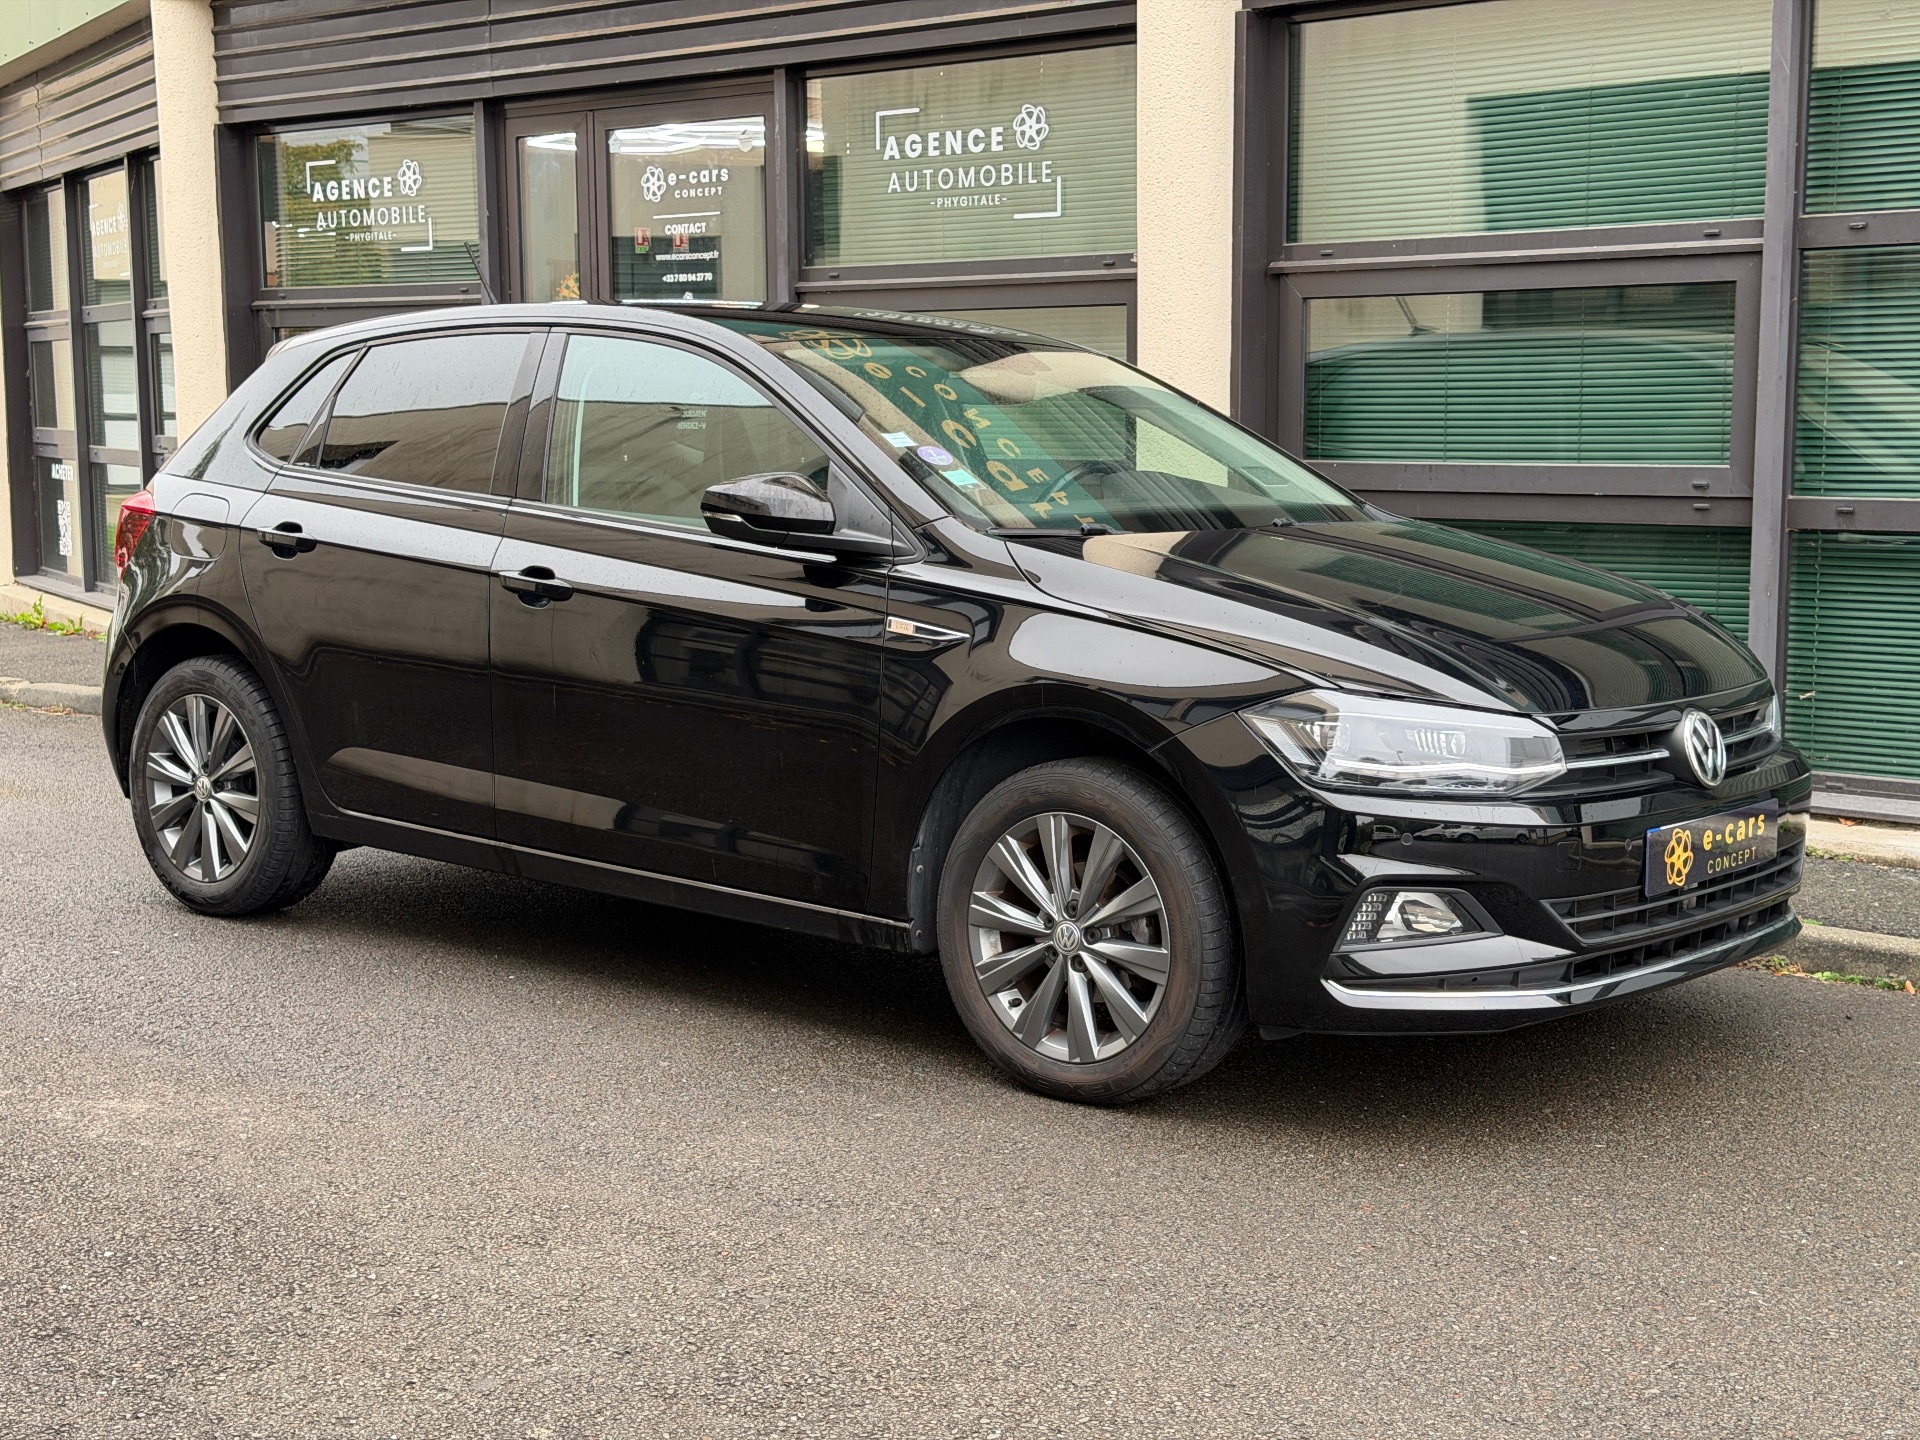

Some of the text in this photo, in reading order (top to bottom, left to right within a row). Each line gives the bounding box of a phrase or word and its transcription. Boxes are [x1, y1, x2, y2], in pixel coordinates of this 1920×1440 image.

[883, 126, 1004, 161] AGENCE
[312, 176, 393, 202] AGENCE
[667, 168, 729, 186] e-cars
[887, 160, 1053, 194] AUTOMOBILE
[674, 186, 723, 199] CONCEPT
[92, 216, 117, 237] AGENCE
[316, 204, 426, 230] AUTOMOBILE
[664, 222, 707, 235] CONTACT
[51, 463, 74, 481] ACHETER
[1702, 814, 1766, 851] e-cars
[1707, 847, 1757, 874] CONCEPT
